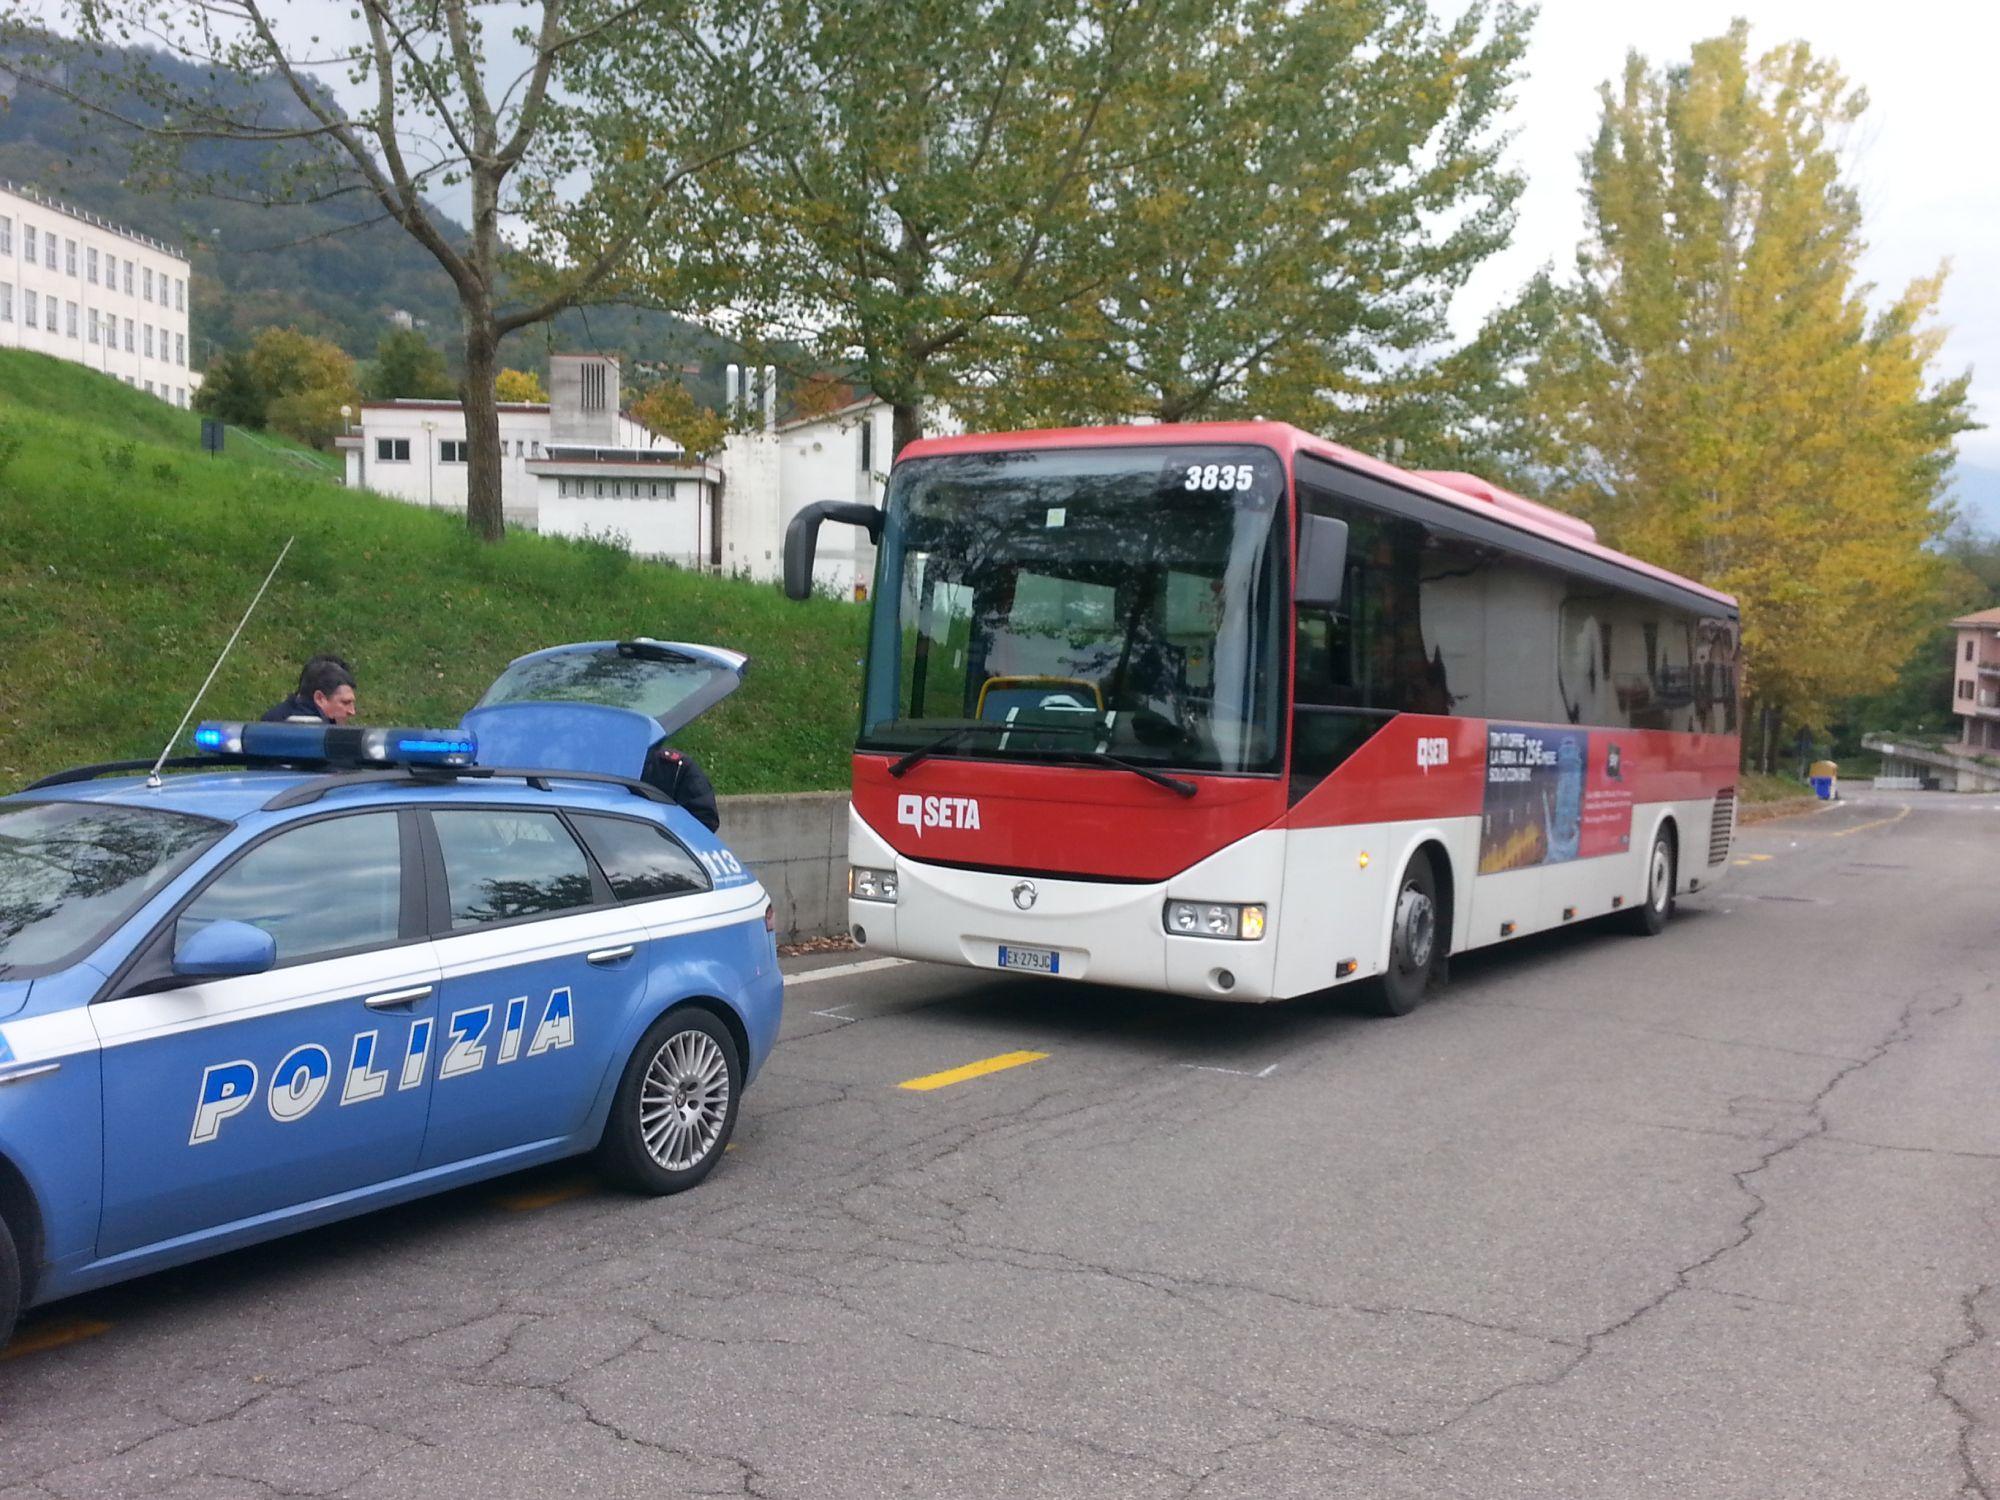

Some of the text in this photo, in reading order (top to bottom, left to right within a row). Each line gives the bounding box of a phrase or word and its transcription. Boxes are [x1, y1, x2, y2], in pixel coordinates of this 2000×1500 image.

[1184, 464, 1254, 491] 3835
[923, 795, 981, 830] SETA
[700, 848, 742, 876] 113
[188, 986, 575, 1146] POLIZIA
